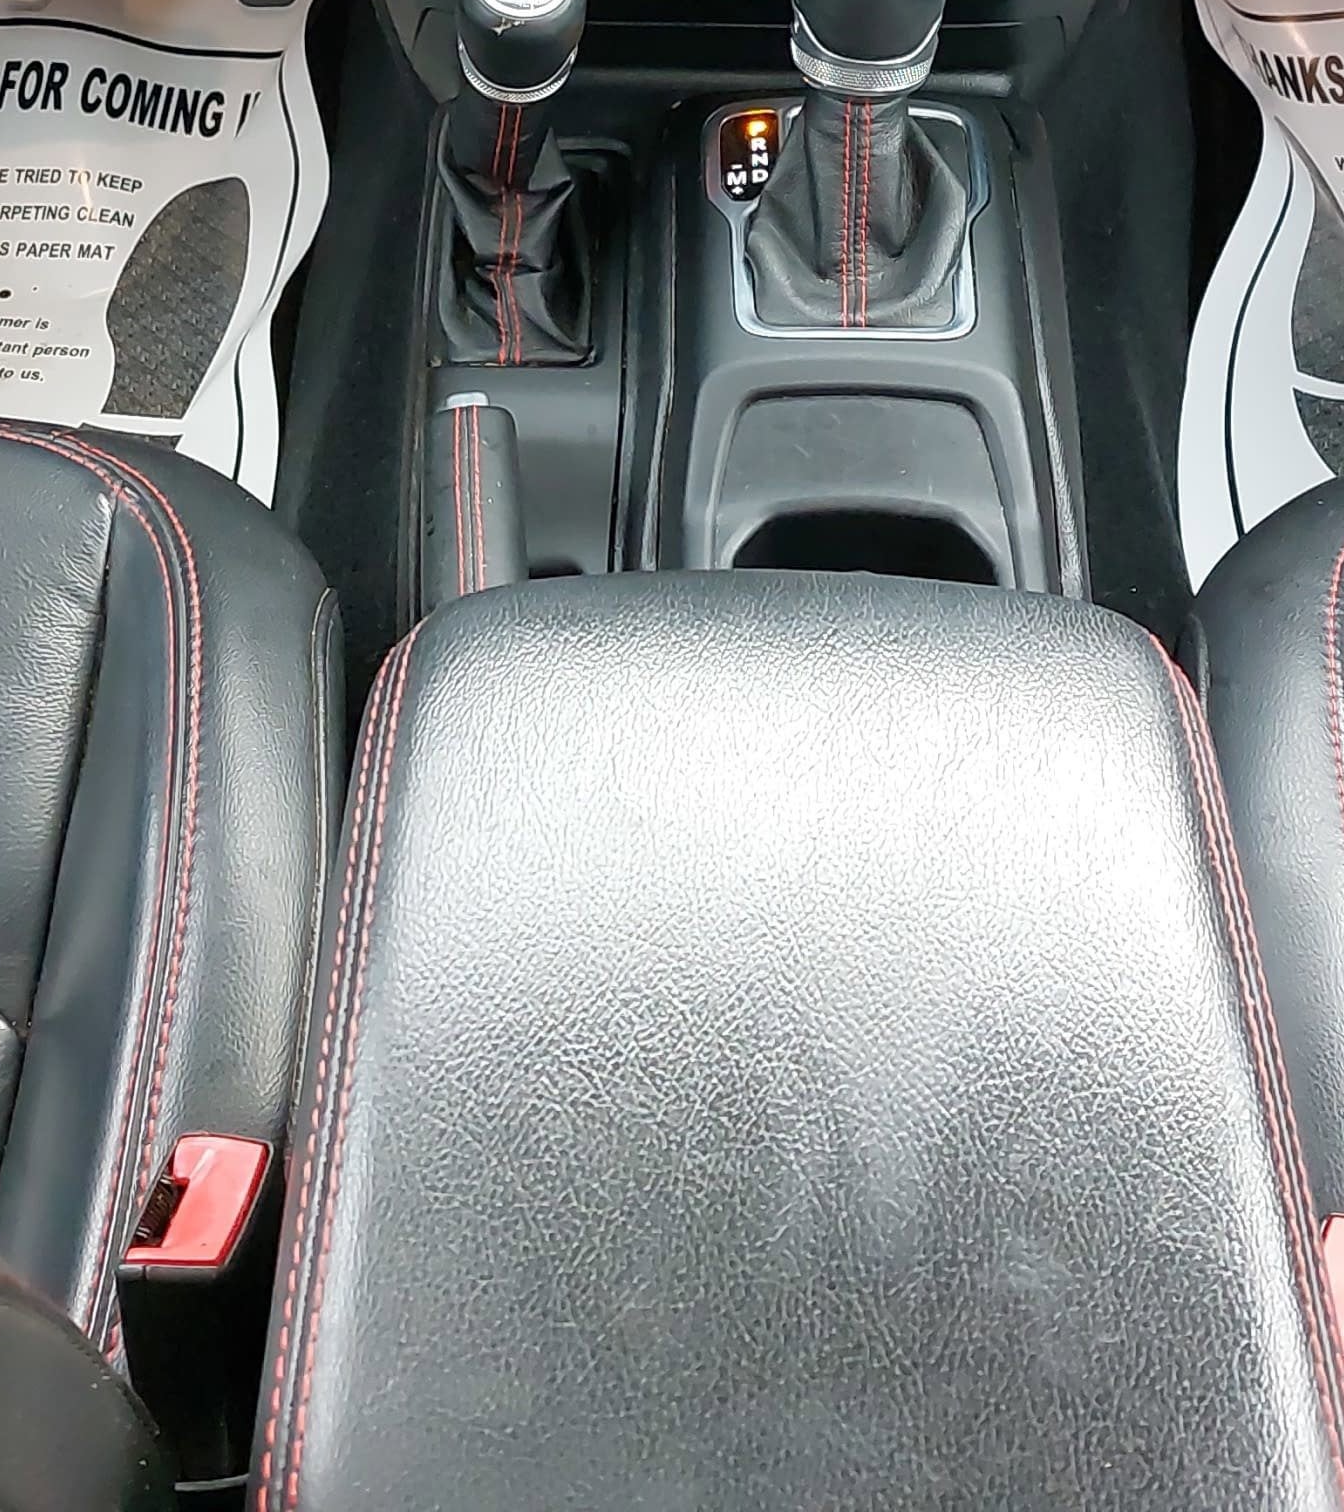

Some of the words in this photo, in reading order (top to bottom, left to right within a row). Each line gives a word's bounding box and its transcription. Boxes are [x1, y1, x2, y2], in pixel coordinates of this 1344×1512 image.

[80, 67, 224, 138] COMING
[15, 168, 62, 184] TRIED
[69, 169, 91, 185] TO
[96, 173, 143, 194] KEEP
[77, 206, 135, 227] CLEAN
[15, 242, 72, 258] PAPER
[77, 243, 115, 260] MAT
[35, 317, 50, 330] is
[31, 343, 90, 358] person
[20, 370, 45, 382] us.
